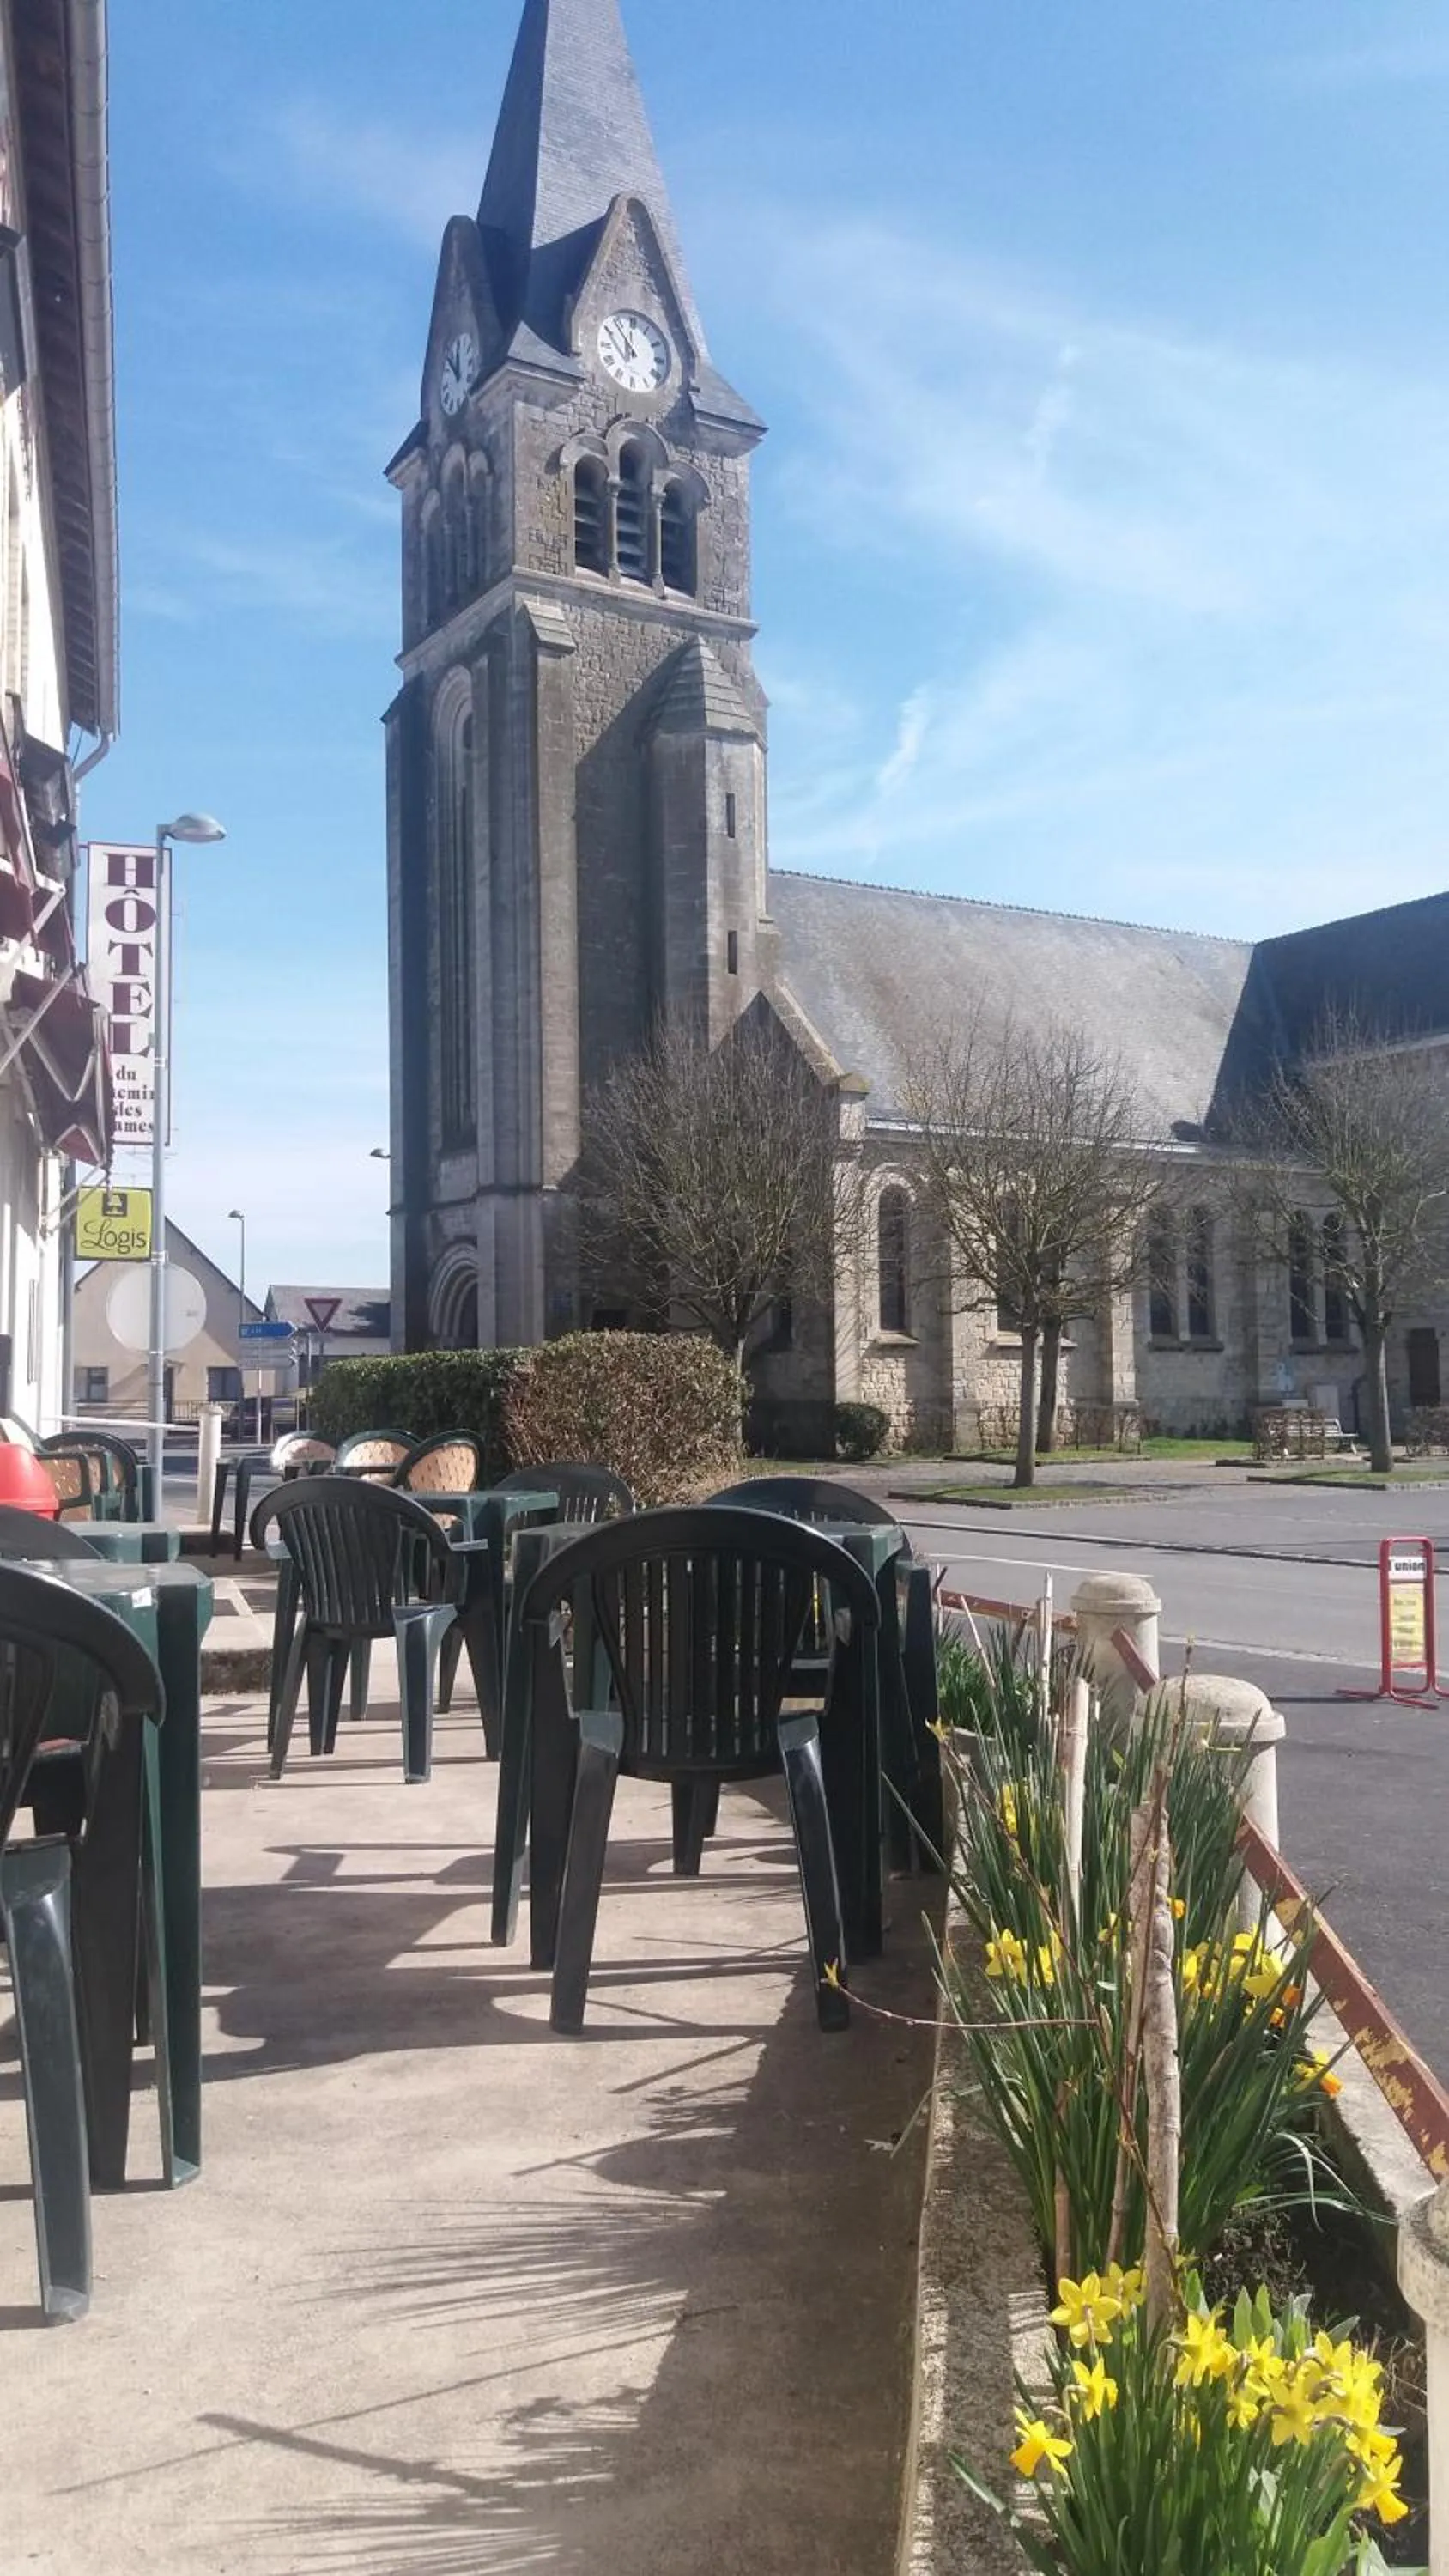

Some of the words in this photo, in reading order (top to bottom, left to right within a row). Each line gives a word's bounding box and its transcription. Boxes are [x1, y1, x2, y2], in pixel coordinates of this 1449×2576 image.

[103, 852, 158, 1058] HÔTEL
[116, 1065, 137, 1081] du
[81, 1218, 147, 1255] Logis
